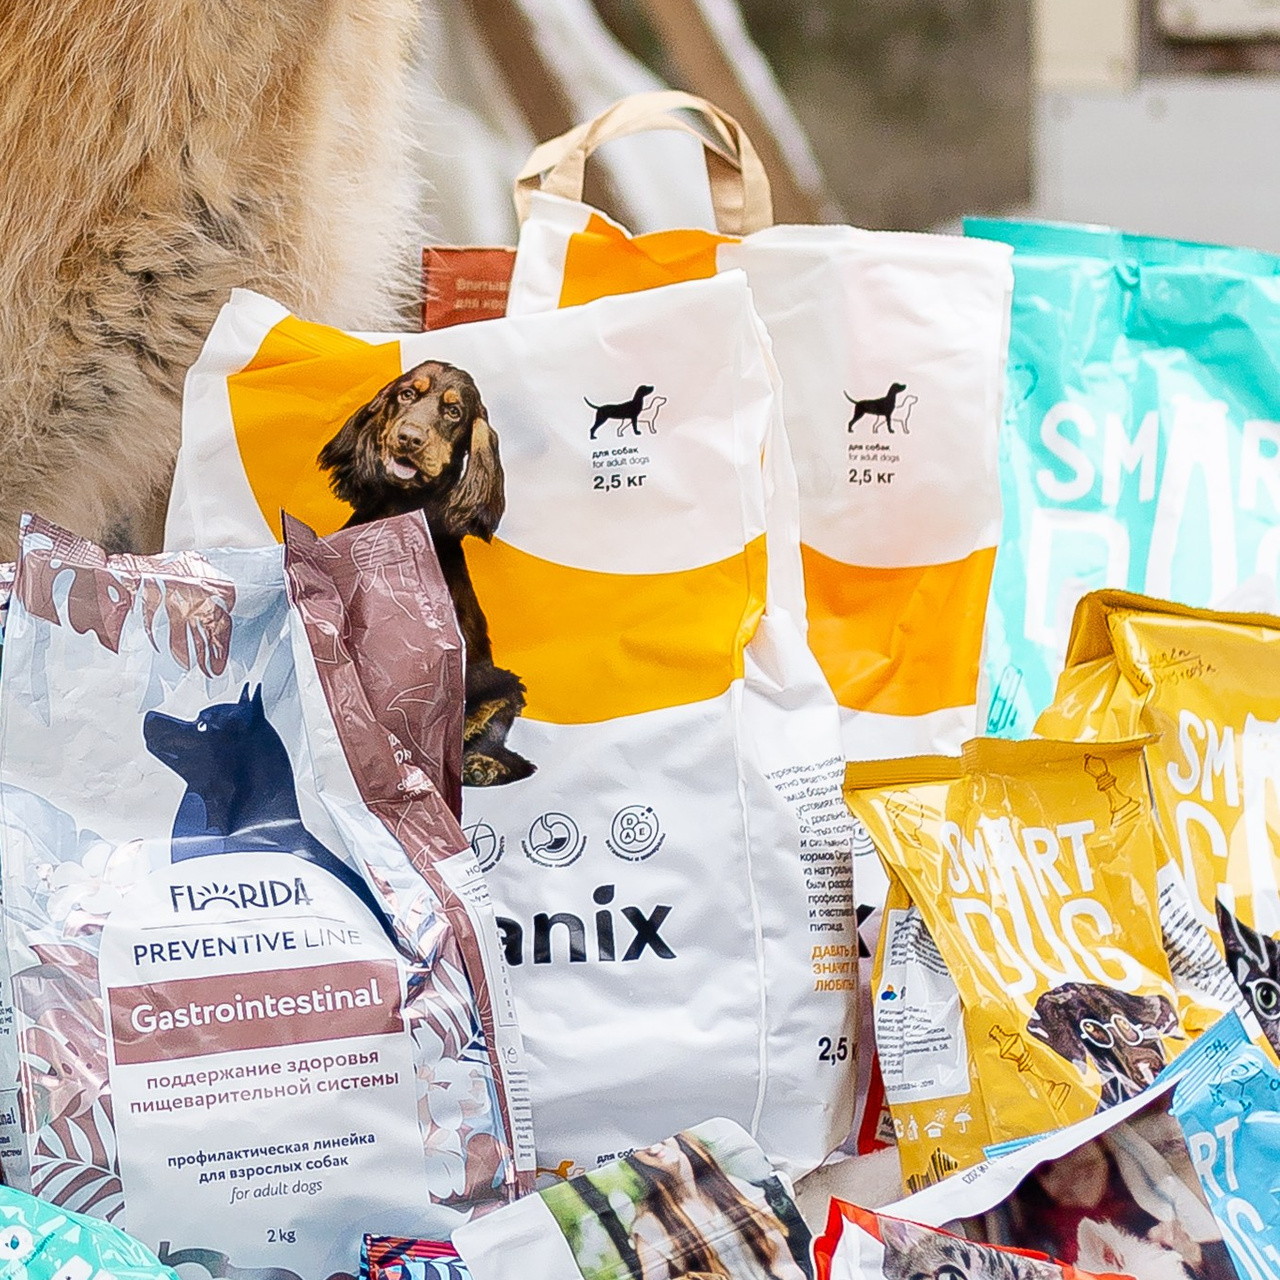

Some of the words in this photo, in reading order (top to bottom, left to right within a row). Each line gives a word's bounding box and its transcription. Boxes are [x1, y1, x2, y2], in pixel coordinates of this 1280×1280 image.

[592, 450, 609, 460] для
[611, 446, 639, 456] собак
[593, 474, 622, 493] 2,5
[627, 474, 647, 488] кг
[848, 468, 872, 486] 2,5
[877, 472, 896, 484] кг
[938, 815, 1096, 898] SMART
[133, 930, 298, 966] PREVENTIVE
[304, 928, 363, 949] LINE
[130, 978, 384, 1034] Gastrointestinal
[818, 1036, 849, 1066] 2,5
[146, 1060, 283, 1091] поддержание
[286, 1051, 380, 1076] здоровья
[130, 1078, 312, 1114] пищеварительной
[316, 1072, 400, 1092] системы
[167, 1140, 310, 1170] профилактическая
[313, 1133, 376, 1151] линейка
[198, 1171, 226, 1185] для
[230, 1161, 303, 1181] взрослых
[306, 1155, 350, 1171] собак
[229, 1186, 251, 1205] for
[253, 1182, 289, 1198] adult
[291, 1179, 324, 1196] dogs
[266, 1229, 277, 1243] 2
[280, 1228, 297, 1244] kg
